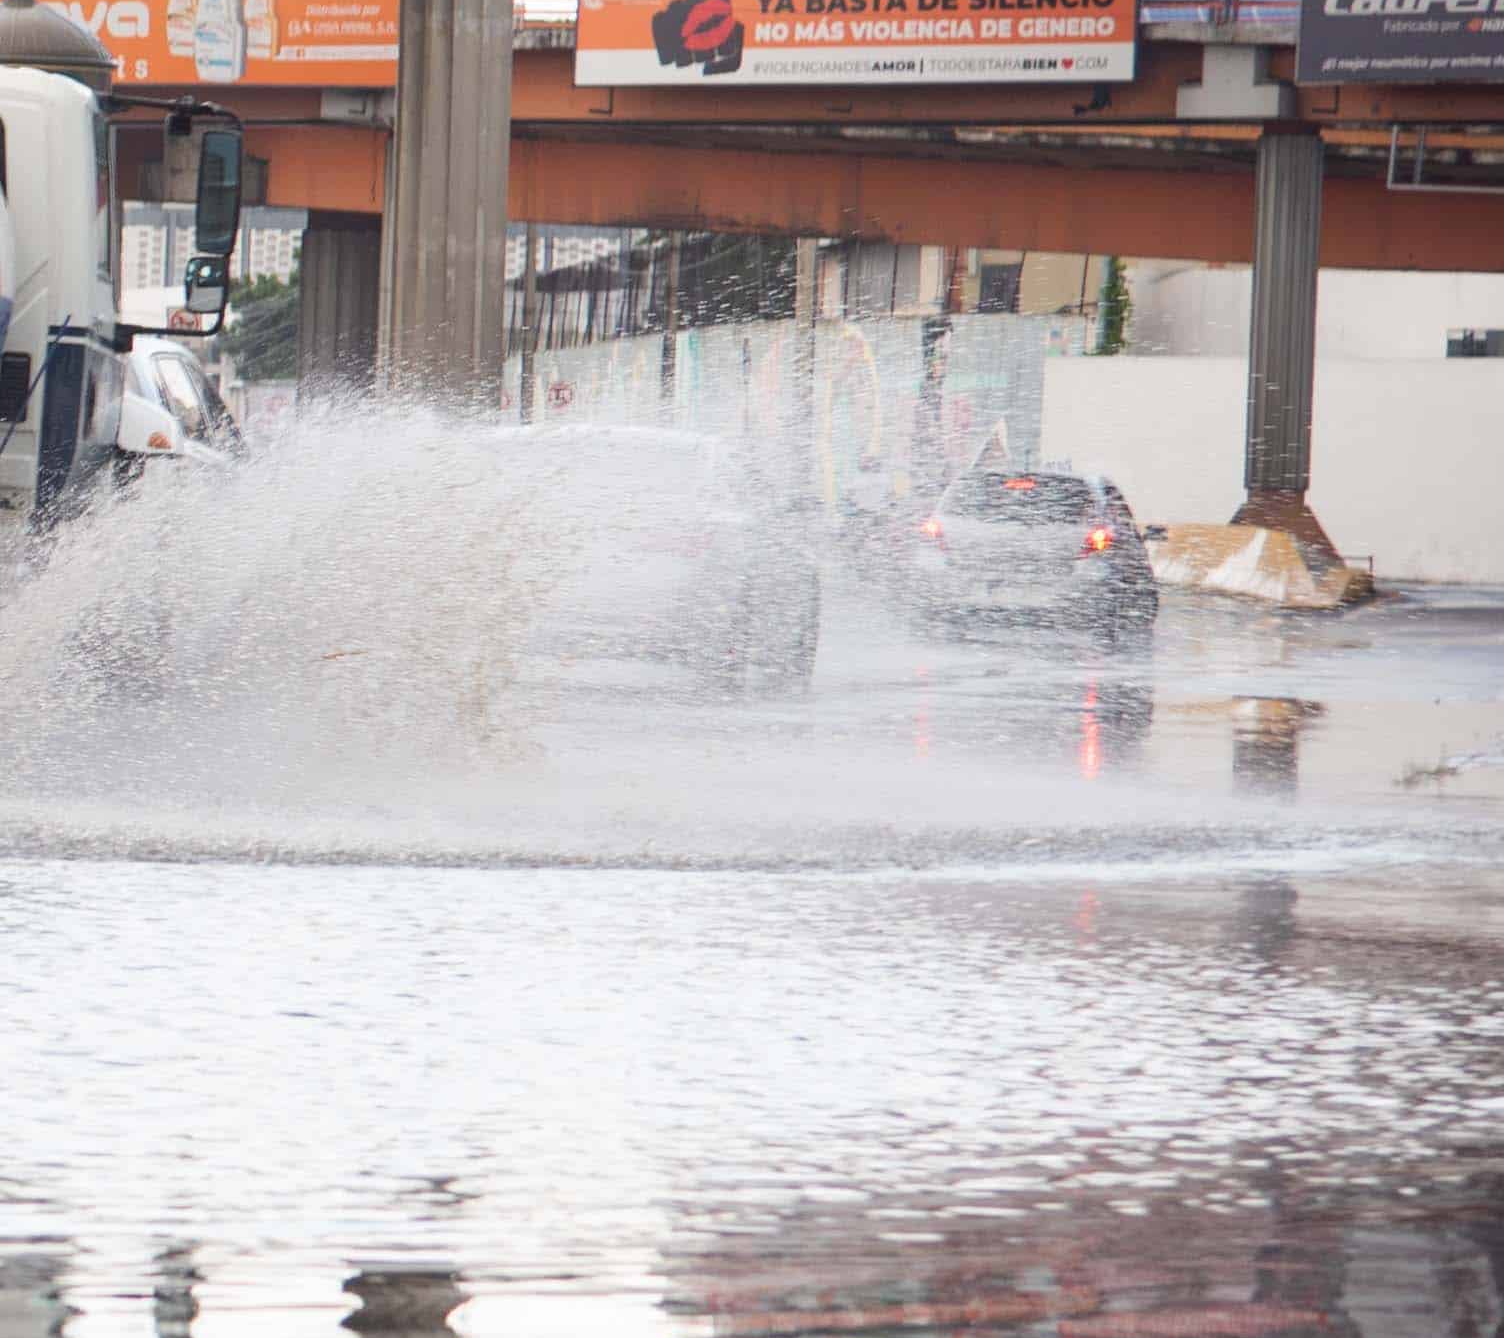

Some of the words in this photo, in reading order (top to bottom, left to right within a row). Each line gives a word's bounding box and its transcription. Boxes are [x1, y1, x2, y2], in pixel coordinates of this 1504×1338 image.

[755, 21, 788, 43] NO
[794, 17, 845, 42] MÁS
[849, 19, 973, 41] VIOLENCIA
[980, 19, 1011, 39] DE
[1018, 16, 1115, 38] GENERO
[1384, 19, 1438, 35] Fabricado
[1441, 21, 1460, 37] por
